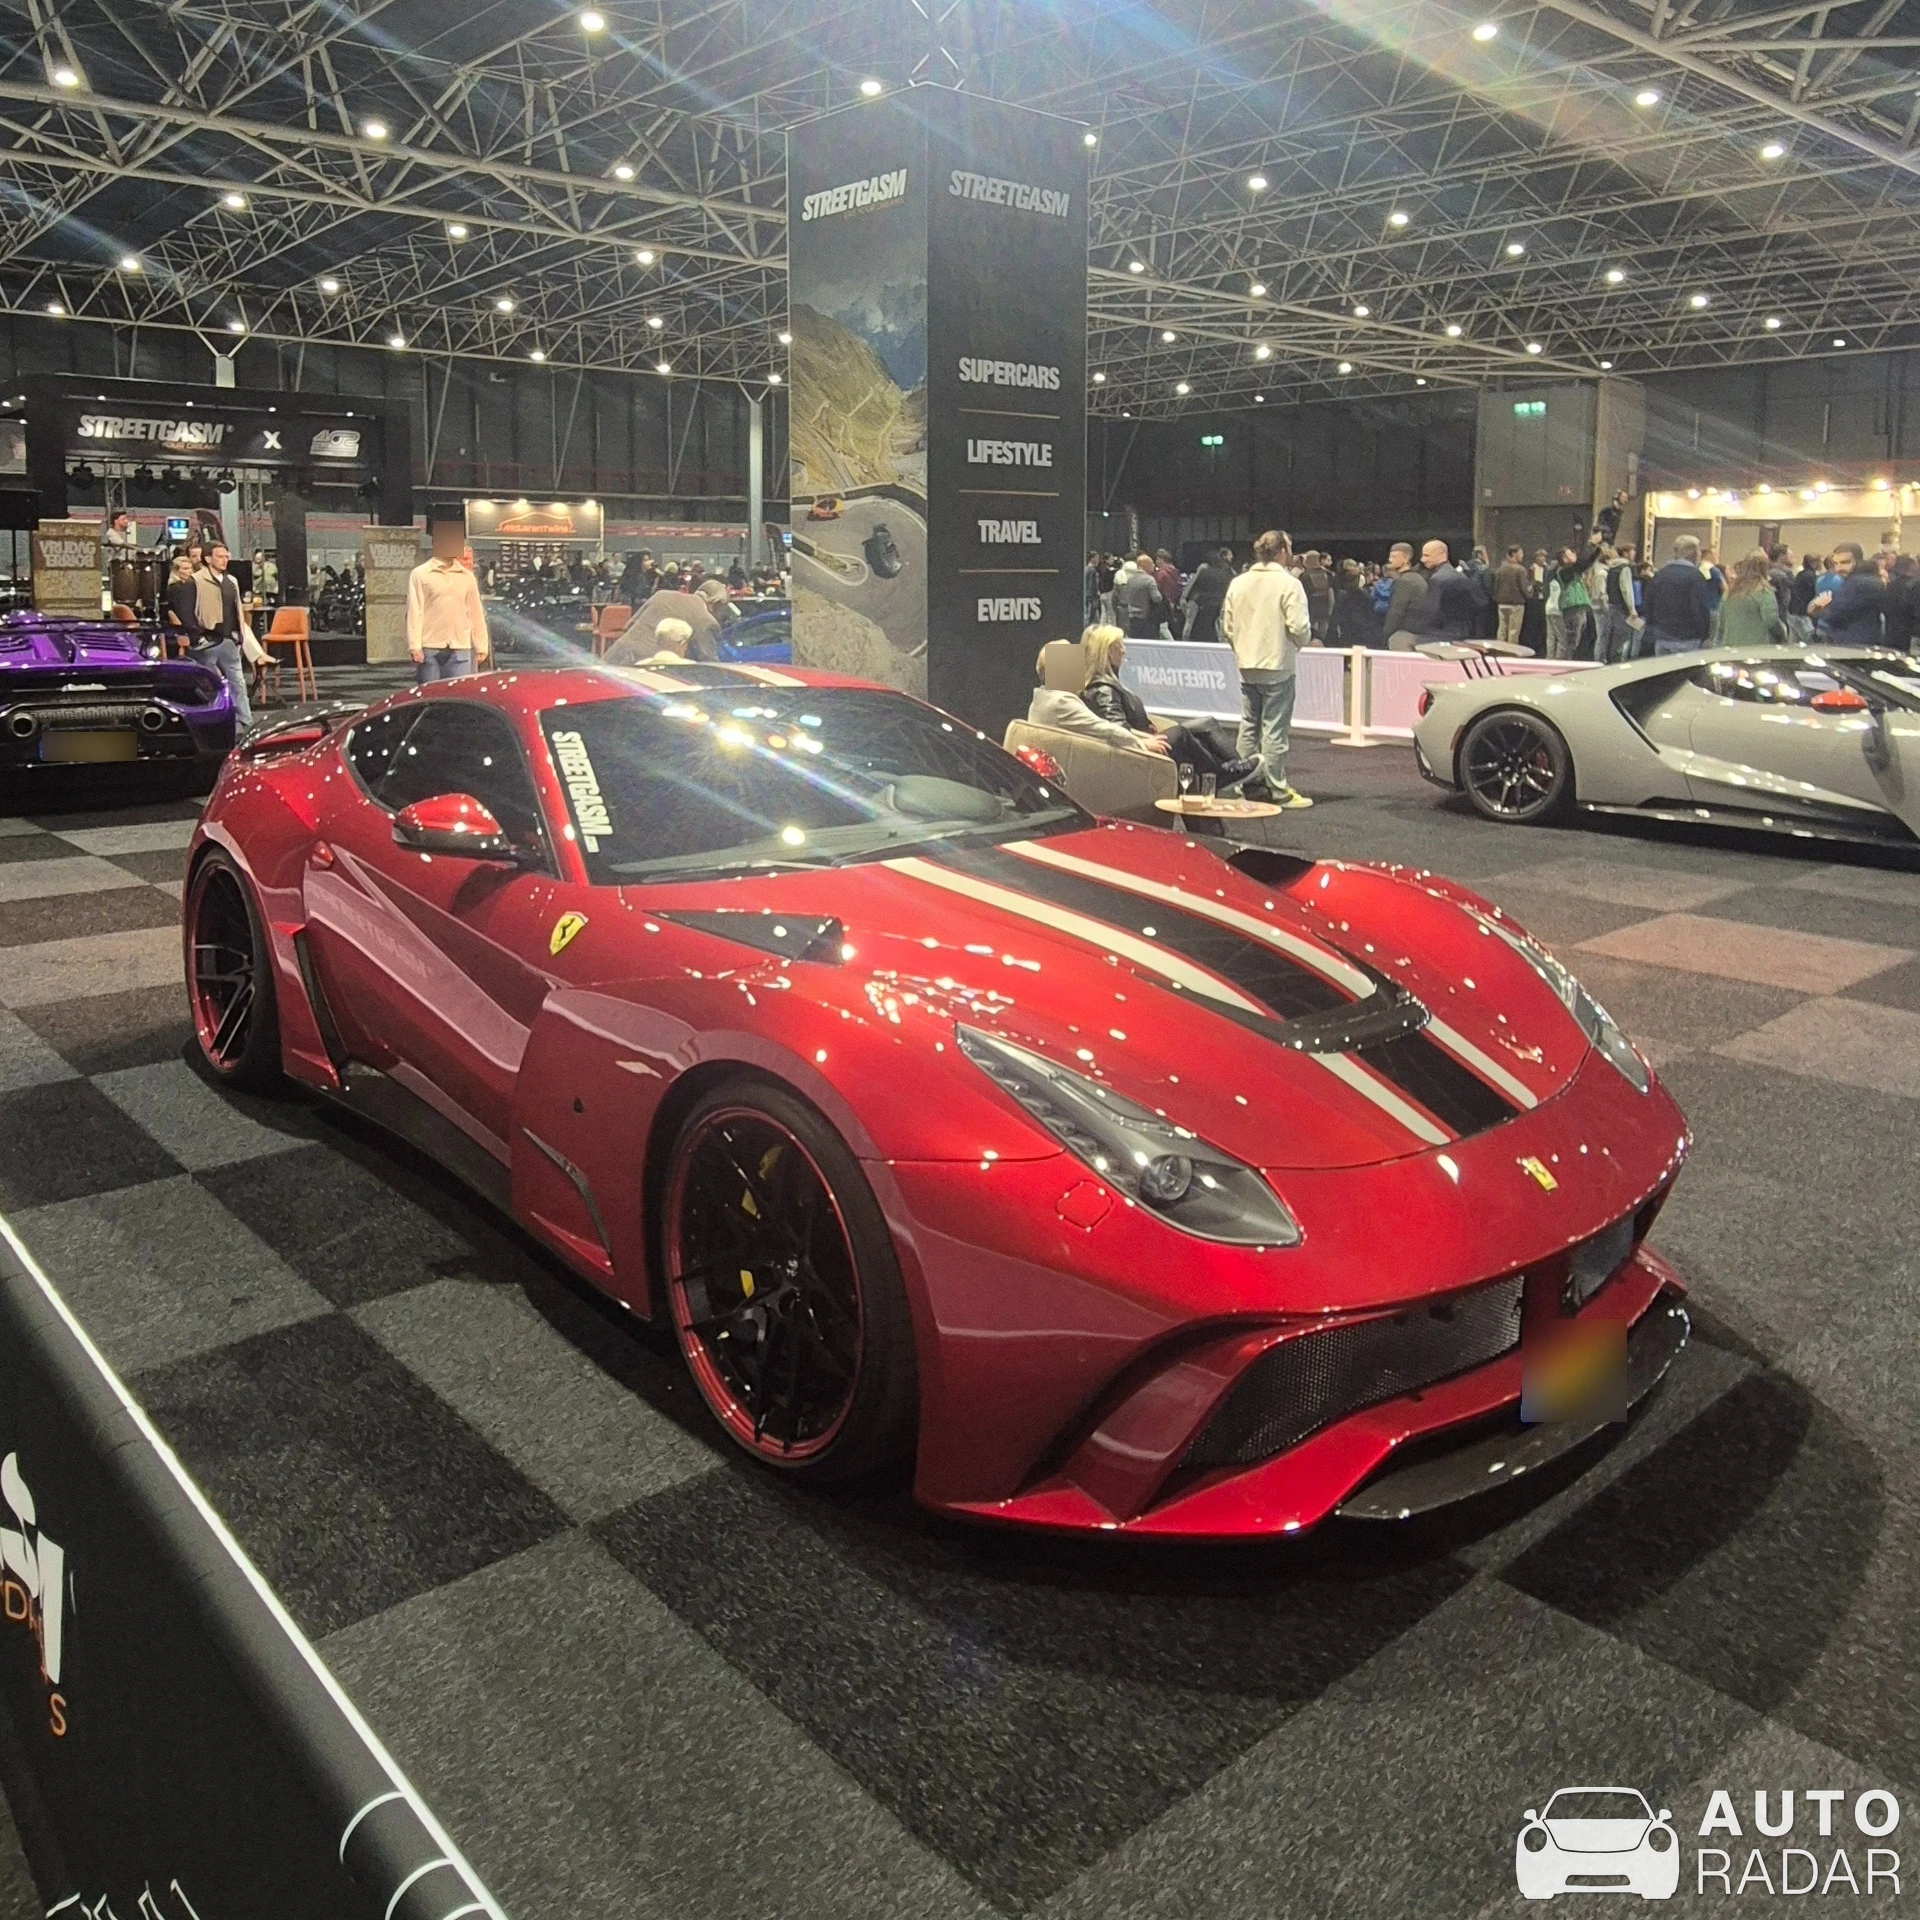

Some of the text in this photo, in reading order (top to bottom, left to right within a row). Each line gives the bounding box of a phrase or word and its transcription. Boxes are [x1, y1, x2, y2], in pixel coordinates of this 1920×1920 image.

[802, 168, 908, 221] STREETGASM
[949, 170, 1071, 217] STREETGASM
[958, 356, 1061, 390] SUPERCARS
[77, 414, 225, 444] STREETGASM
[967, 438, 1053, 467] LIFESTYLE
[977, 519, 1042, 544] TRAVEL
[977, 597, 1042, 622] EVENTS
[551, 731, 614, 836] STREETGASM
